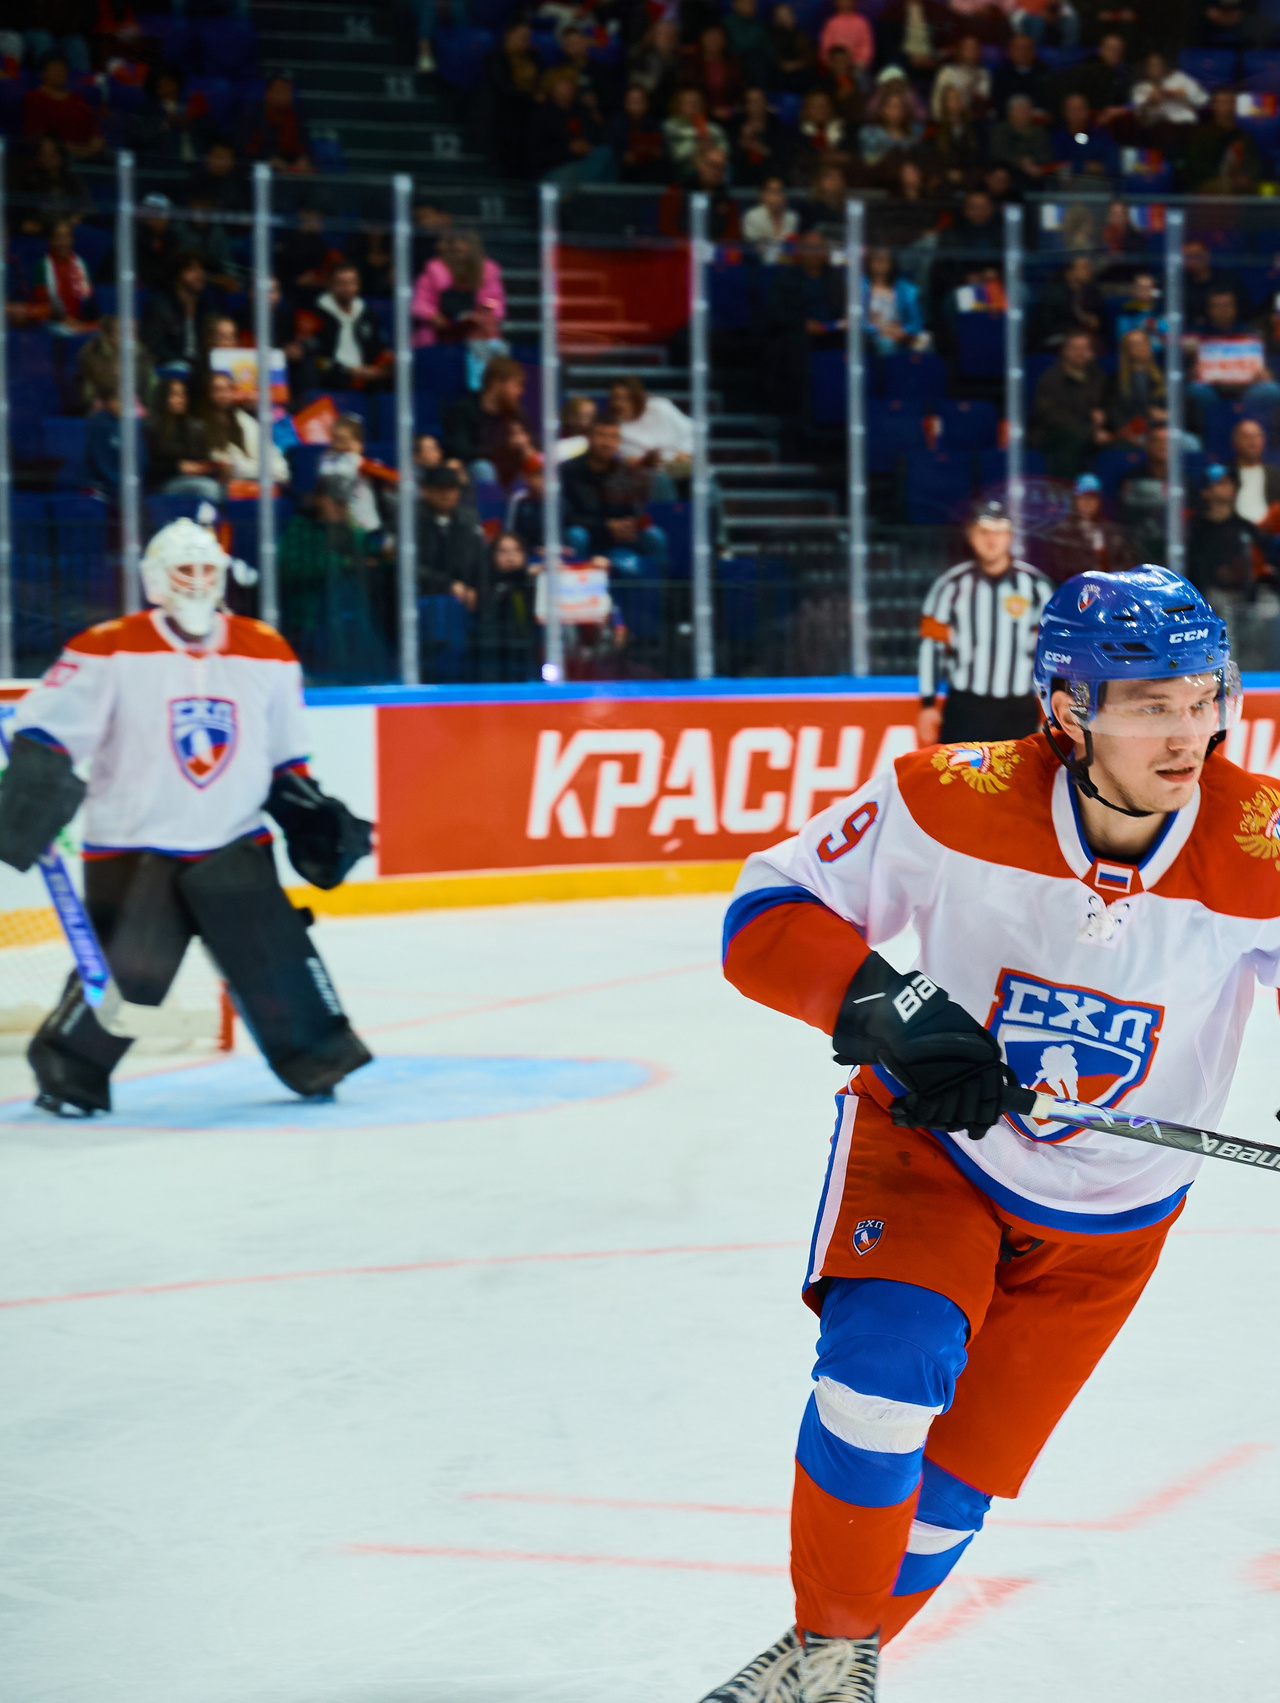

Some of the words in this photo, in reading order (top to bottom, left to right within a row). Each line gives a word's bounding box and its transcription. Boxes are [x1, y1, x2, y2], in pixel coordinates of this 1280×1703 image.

[1168, 627, 1209, 645] CCM
[1044, 650, 1073, 665] CCM
[816, 801, 878, 863] 9
[1002, 980, 1153, 1053] СХЛ
